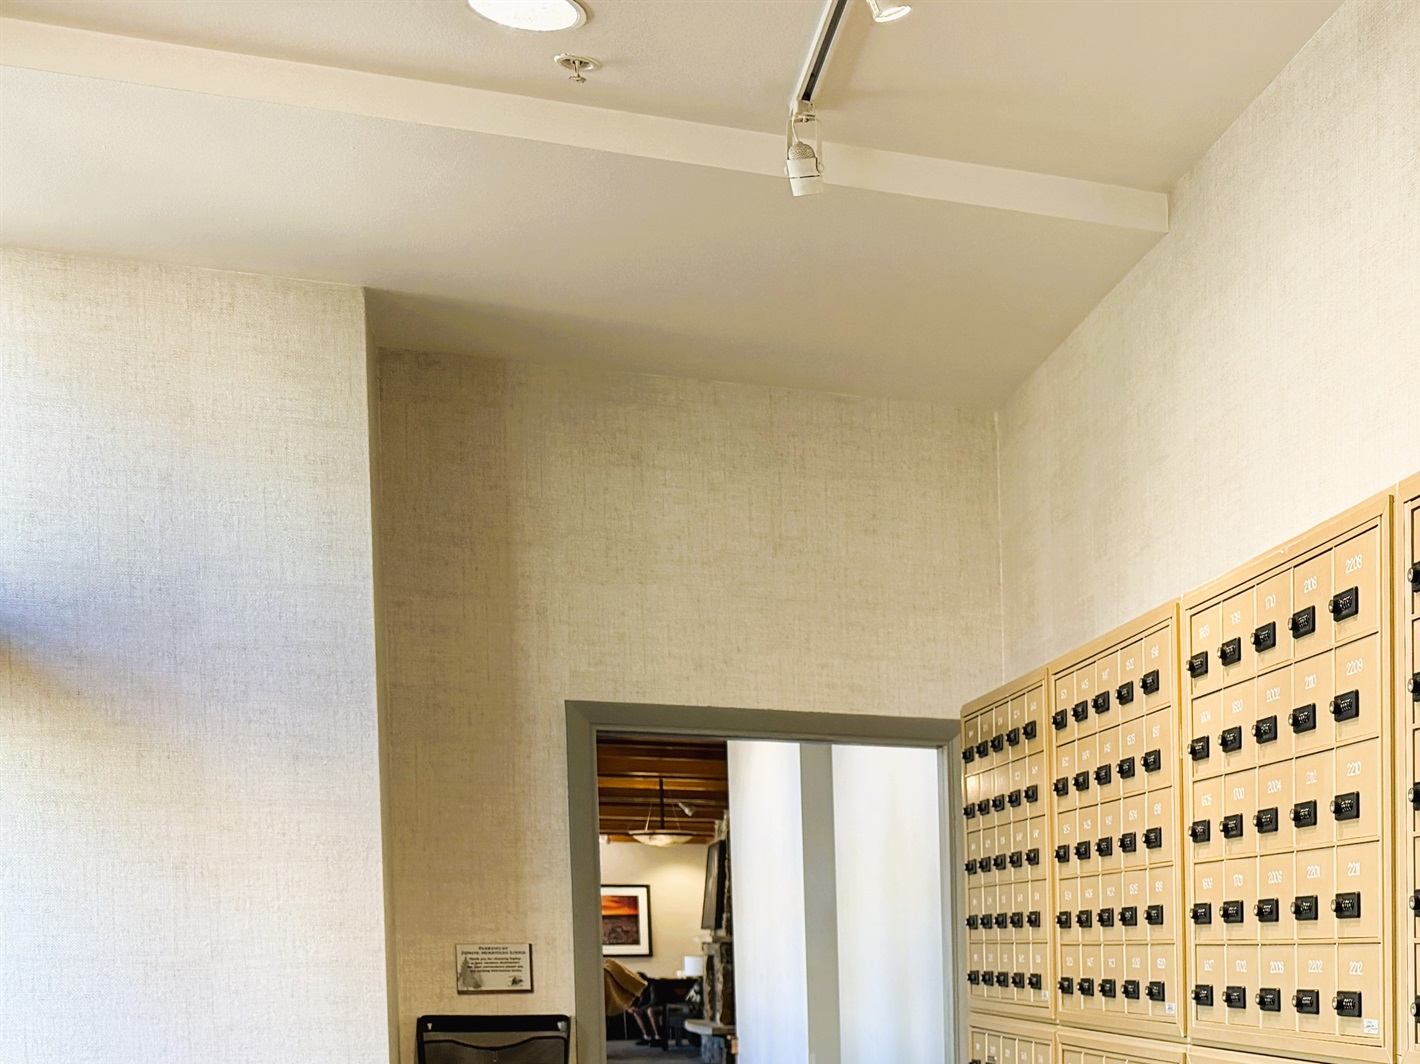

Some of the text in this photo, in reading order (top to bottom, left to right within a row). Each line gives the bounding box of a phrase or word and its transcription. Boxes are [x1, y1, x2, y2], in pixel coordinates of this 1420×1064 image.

[1345, 553, 1363, 574] 2208
[1346, 657, 1363, 676] 2209
[1346, 760, 1362, 777] 2210
[1308, 959, 1323, 973] 2202
